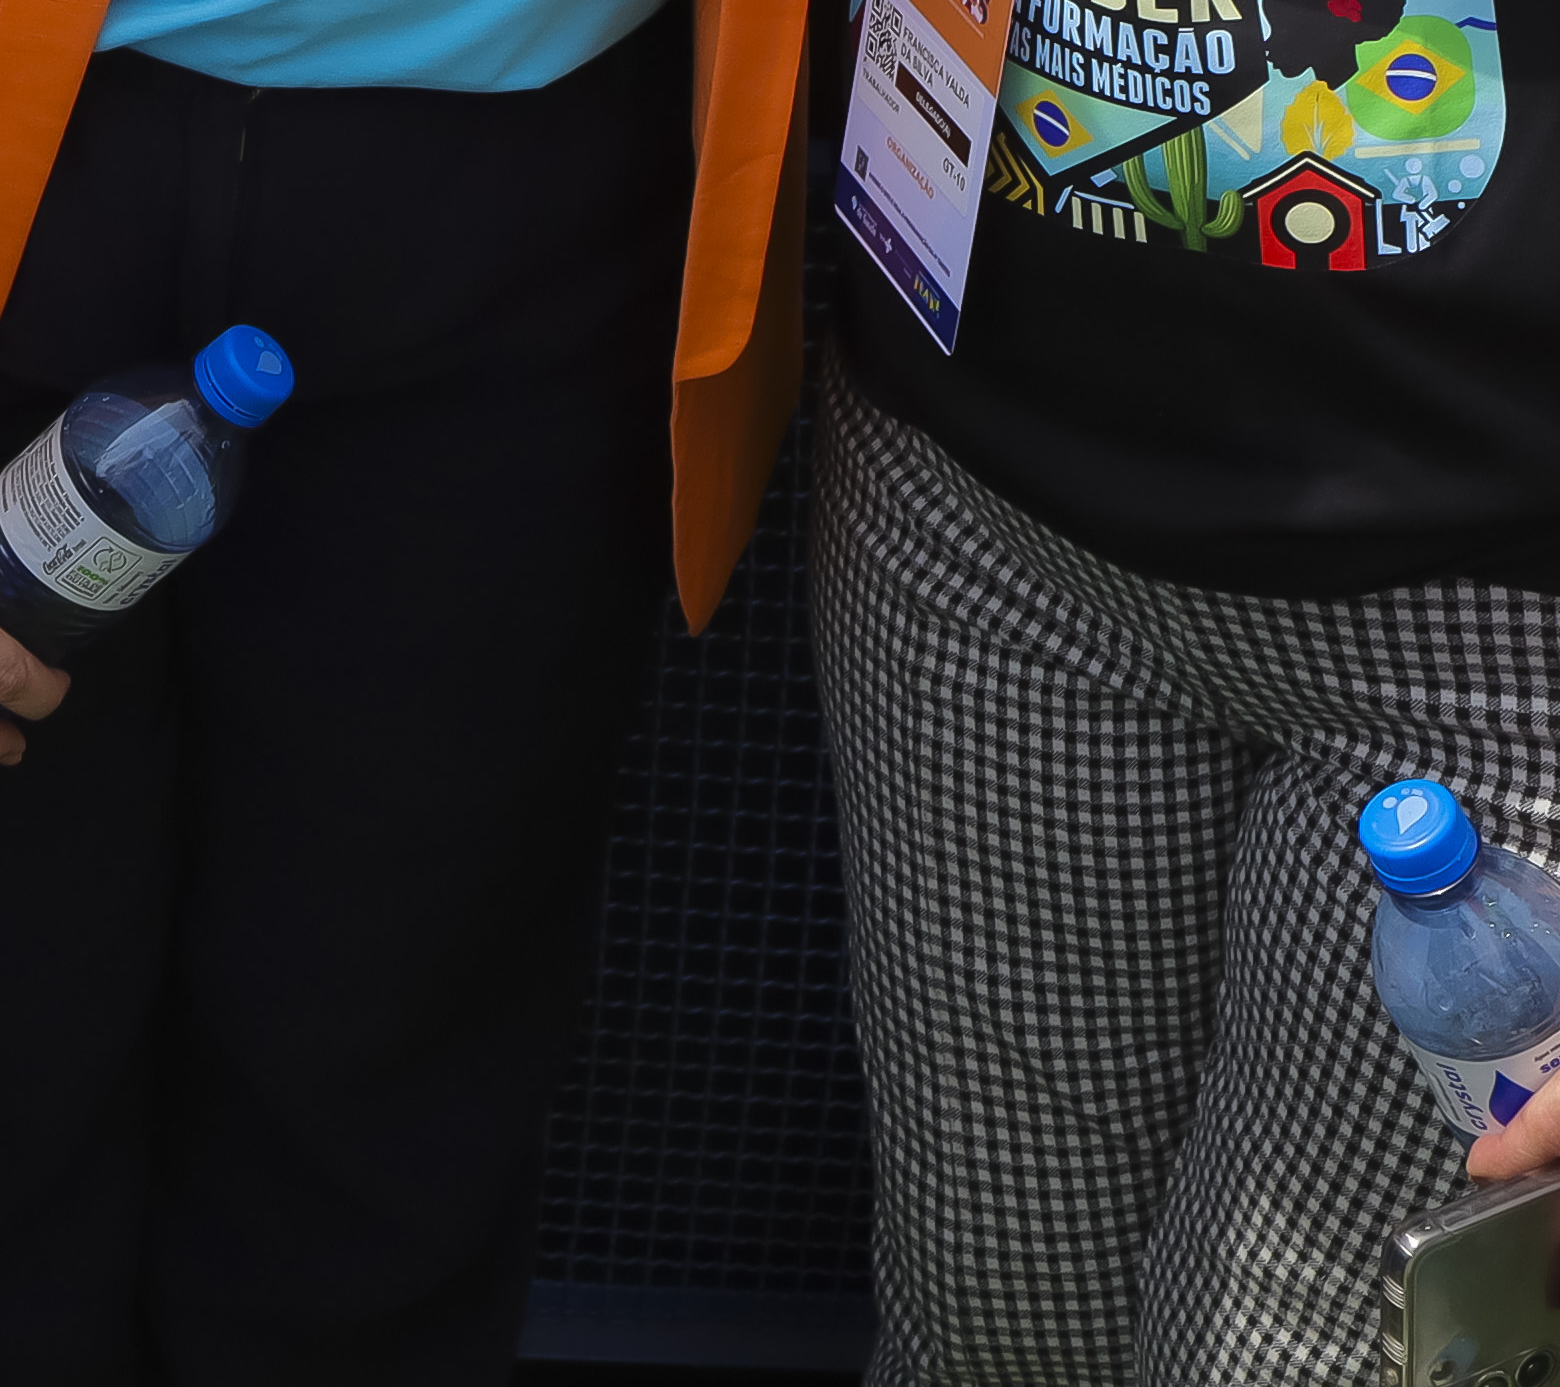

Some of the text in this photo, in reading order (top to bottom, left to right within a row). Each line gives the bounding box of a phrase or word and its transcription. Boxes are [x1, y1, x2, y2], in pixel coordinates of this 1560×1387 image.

[1035, 32, 1085, 89] MAIS
[1091, 54, 1211, 117] MÉDICOS
[1435, 1061, 1489, 1131] crystal
